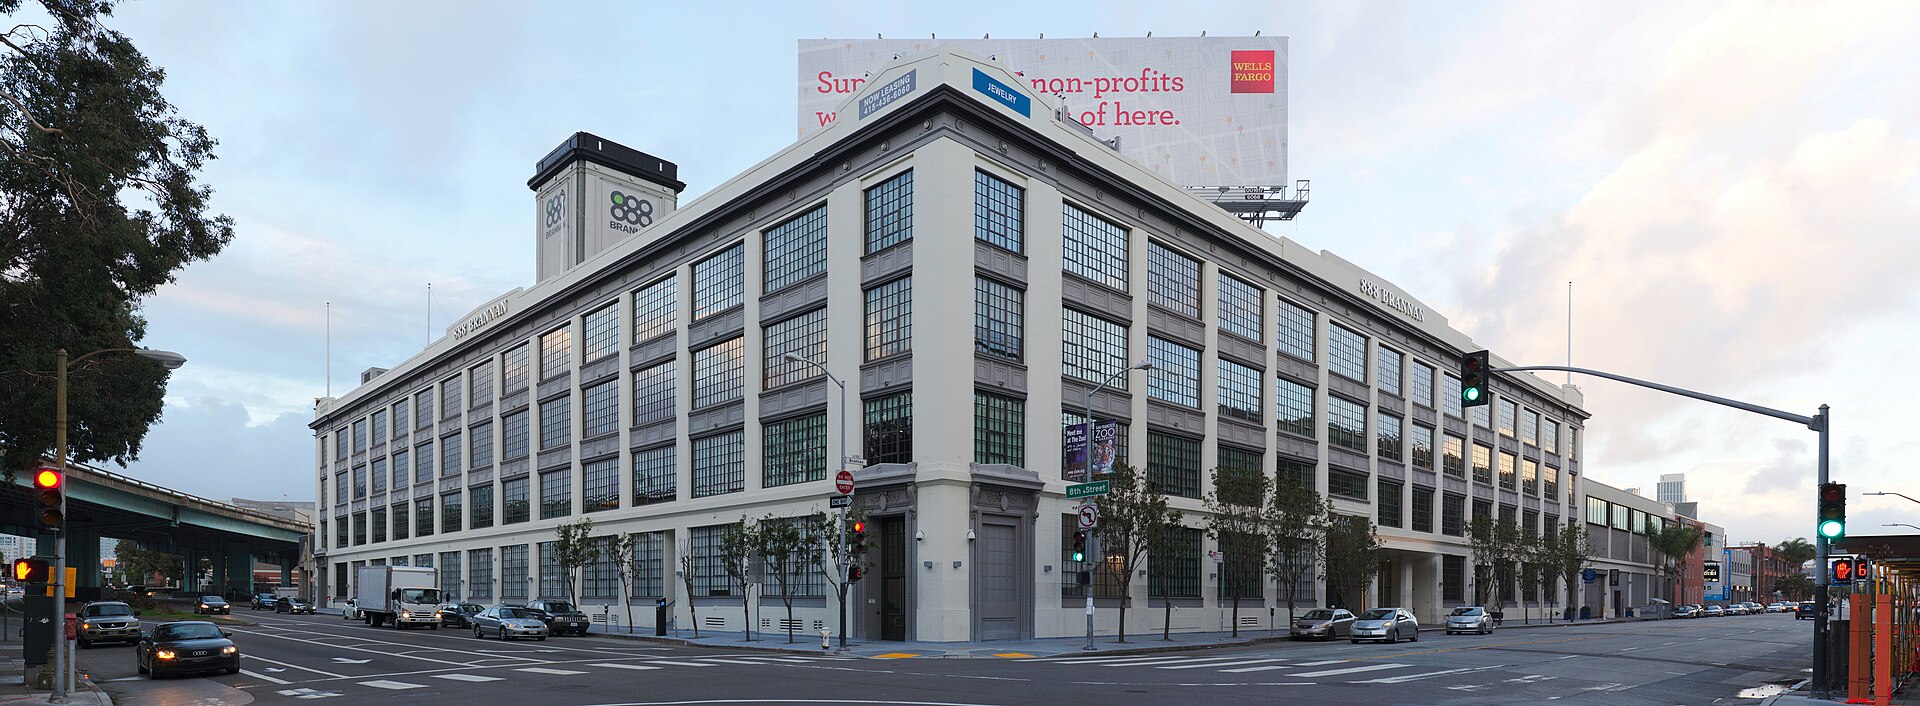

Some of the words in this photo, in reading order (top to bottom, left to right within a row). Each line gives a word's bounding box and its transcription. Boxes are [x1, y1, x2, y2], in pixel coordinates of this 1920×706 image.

[1233, 62, 1272, 71] WELLS
[1235, 72, 1272, 82] FARGO
[864, 92, 880, 107] NOW
[881, 75, 910, 97] LEASING
[988, 82, 1017, 104] JEWELRY
[1031, 67, 1184, 99] non-profits
[864, 83, 910, 115] 415-436-6060
[1080, 101, 1108, 127] of
[1114, 101, 1180, 127] here.
[1360, 277, 1379, 299] 888
[1381, 288, 1425, 323] BRANNAN
[452, 322, 468, 341] 888
[468, 299, 509, 332] BRANNAN
[1096, 428, 1114, 438] ZOO
[1070, 488, 1081, 496] 8th
[1086, 485, 1105, 494] Street
[1858, 563, 1867, 576] 6
